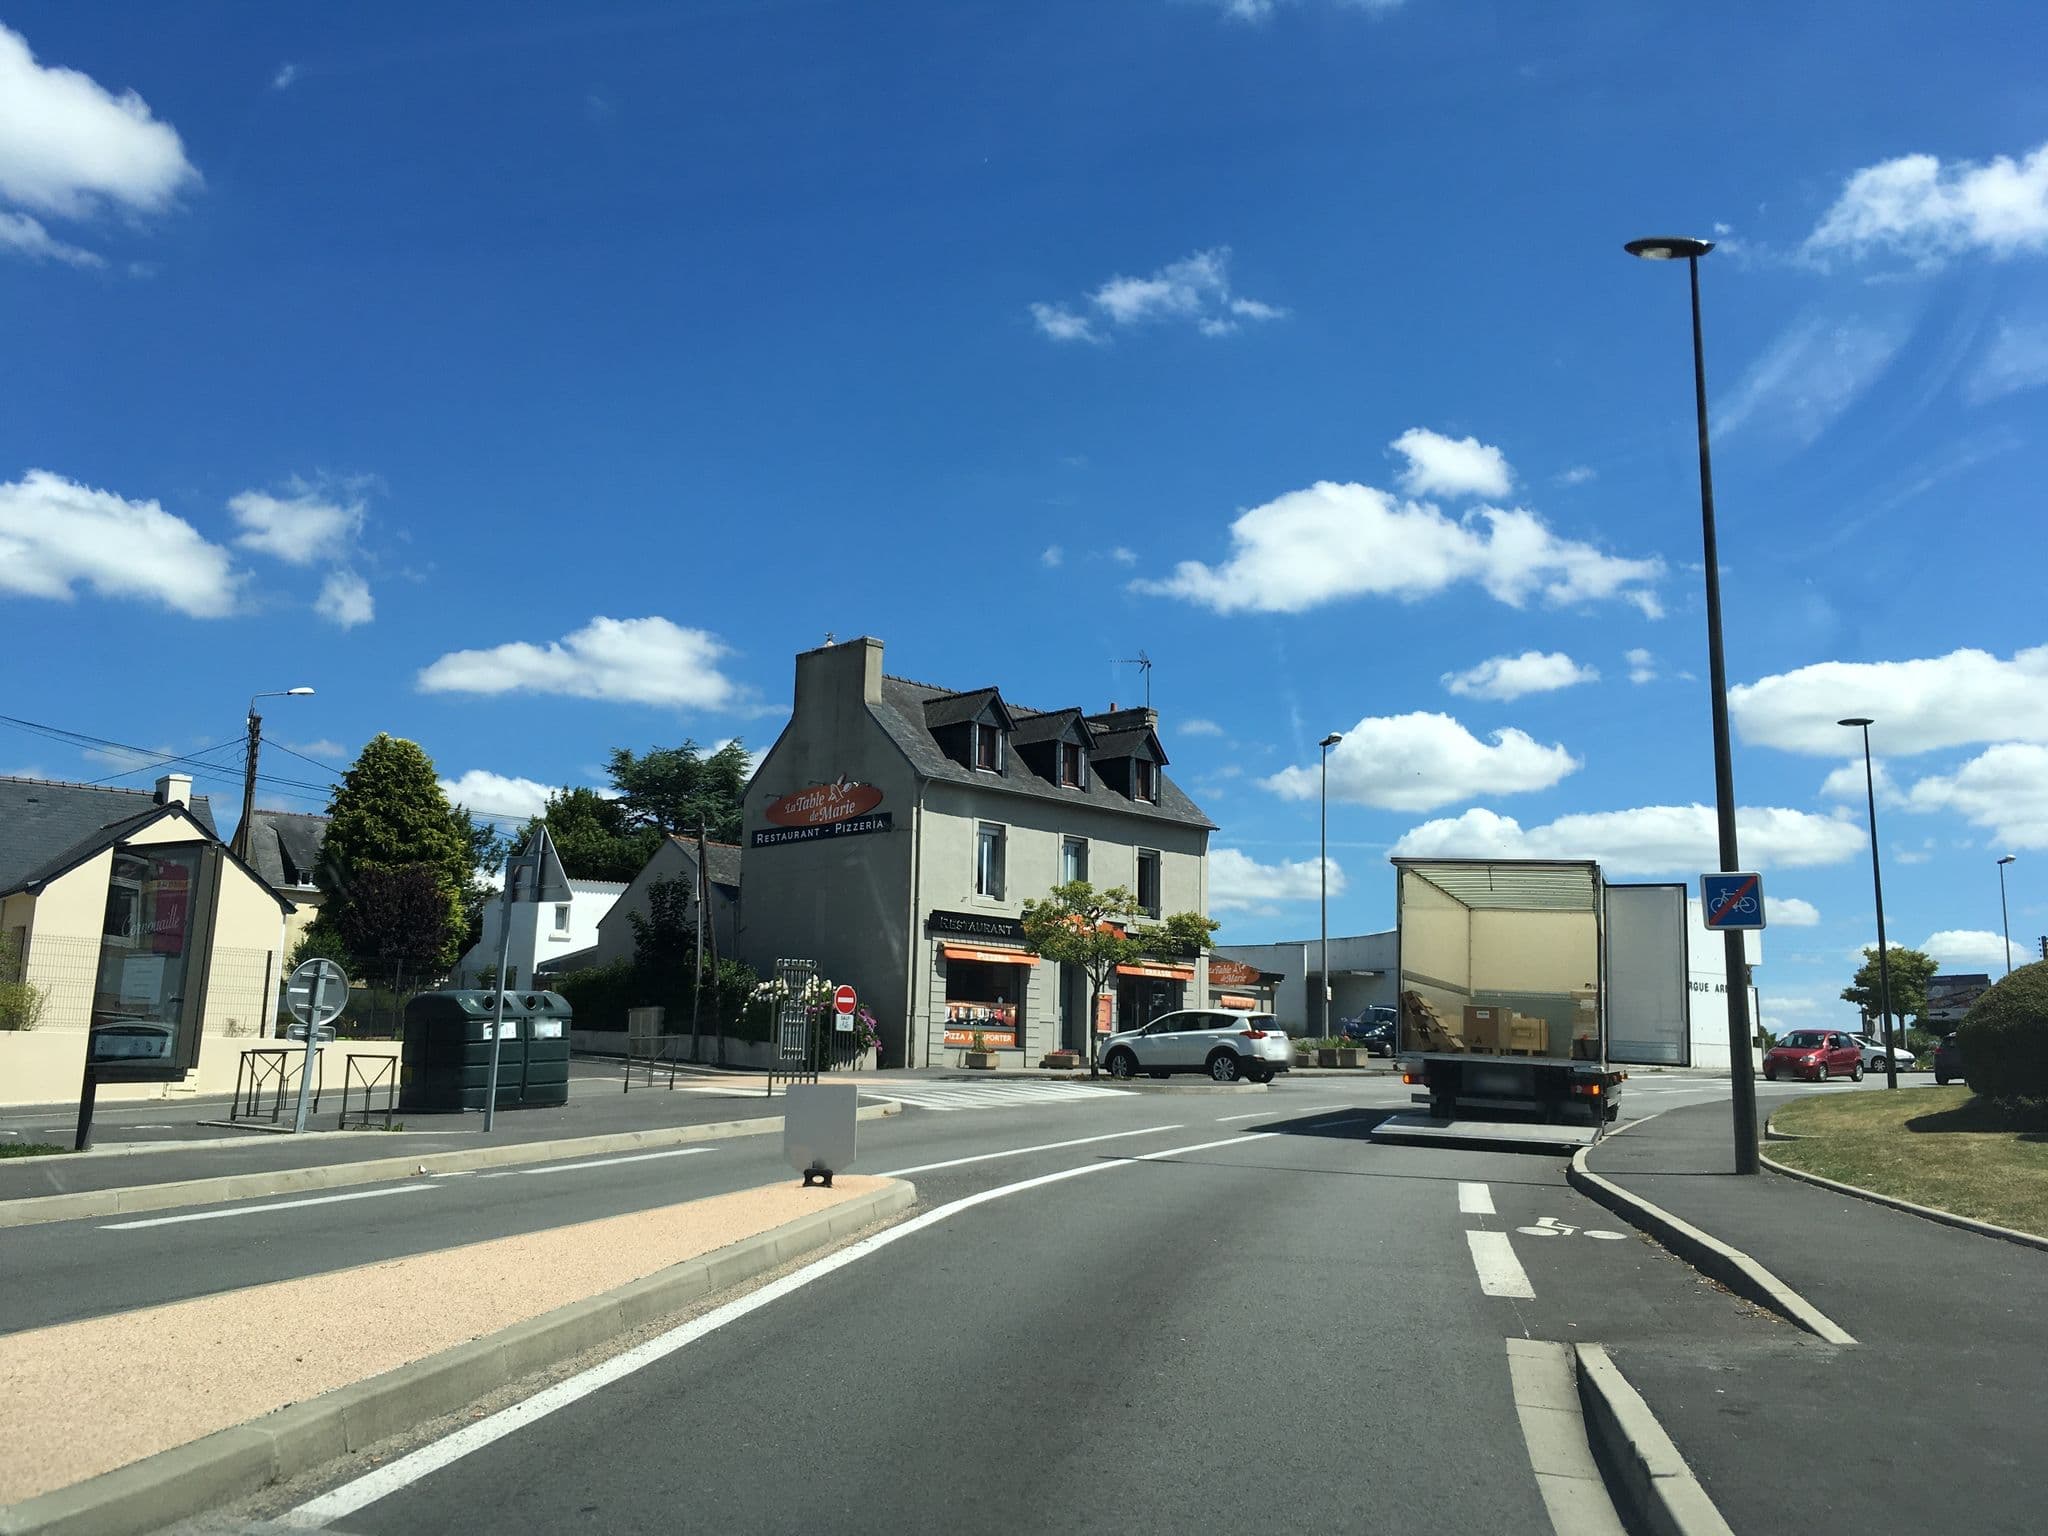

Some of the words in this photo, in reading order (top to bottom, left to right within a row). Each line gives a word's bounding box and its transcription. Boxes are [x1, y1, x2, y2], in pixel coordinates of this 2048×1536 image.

[785, 803, 796, 815] La
[796, 792, 825, 812] Table
[809, 811, 819, 823] de
[819, 800, 856, 821] Marie
[756, 828, 820, 844] RESTAURANT
[835, 819, 884, 834] PIZZERIA
[940, 916, 1013, 935] RESTAURANT
[944, 1031, 966, 1041] PIZZA
